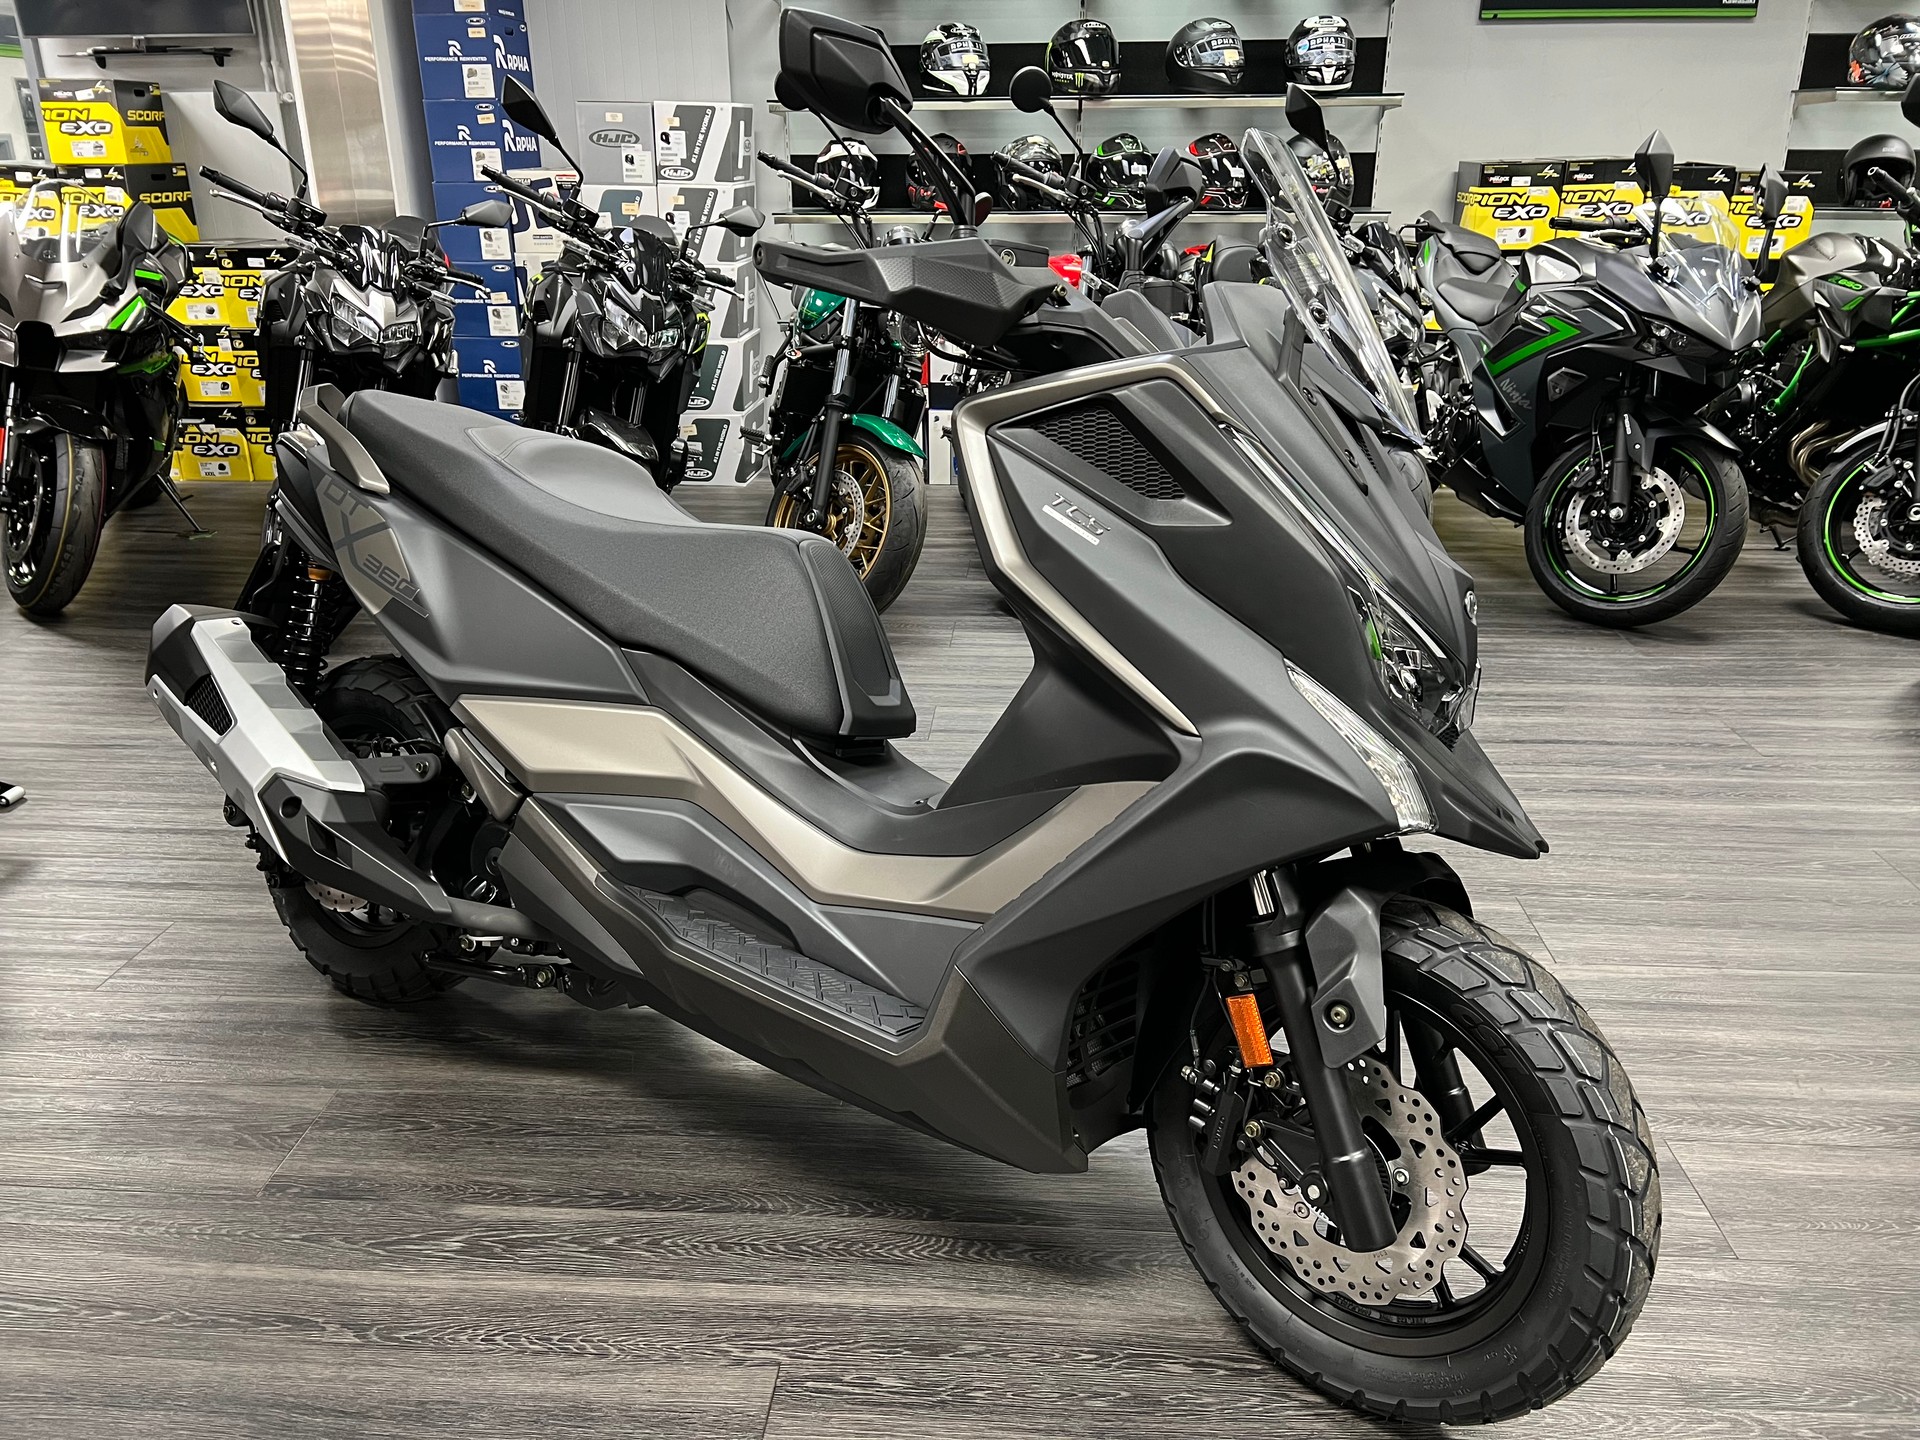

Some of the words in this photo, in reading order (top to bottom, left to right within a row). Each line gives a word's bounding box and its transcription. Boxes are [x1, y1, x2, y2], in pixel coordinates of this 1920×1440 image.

[1310, 36, 1336, 46] RPHA
[507, 54, 530, 72] RPHA
[41, 109, 89, 121] ION
[700, 108, 713, 134] WORLD
[515, 136, 538, 152] RPHA
[595, 133, 633, 144] HJC
[61, 192, 104, 205] ION
[702, 190, 715, 215] WORLD
[1500, 377, 1533, 409] Ninja
[362, 553, 420, 601] 360
